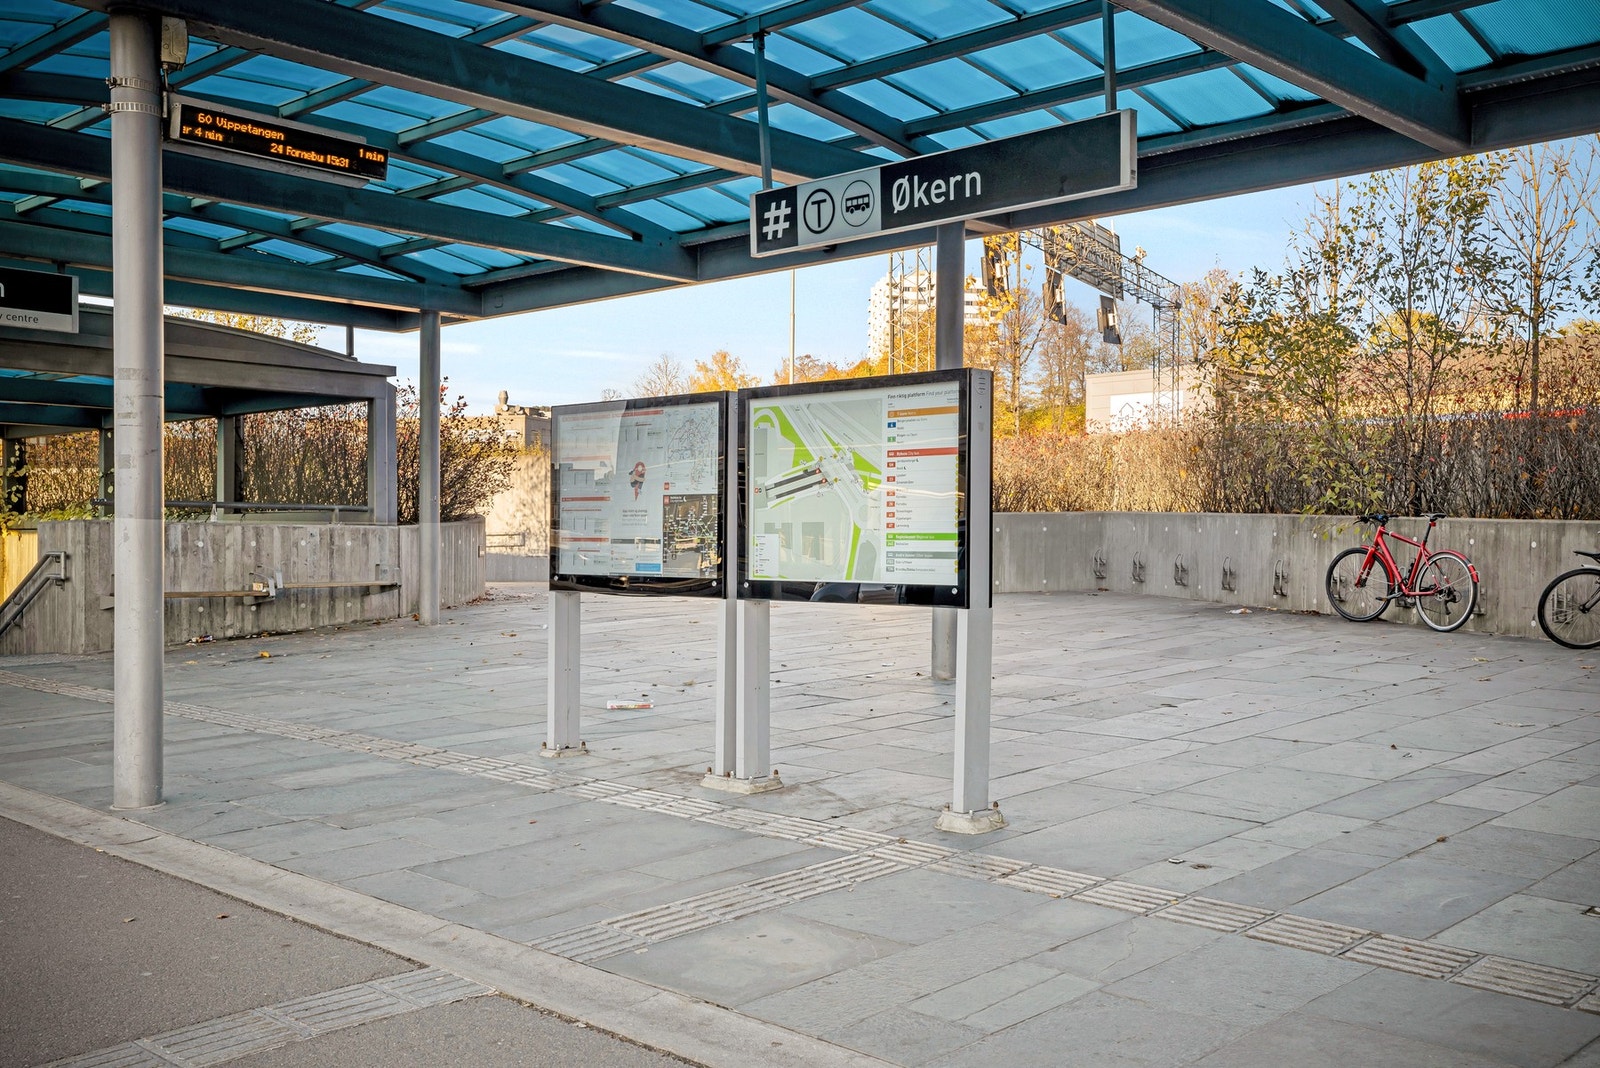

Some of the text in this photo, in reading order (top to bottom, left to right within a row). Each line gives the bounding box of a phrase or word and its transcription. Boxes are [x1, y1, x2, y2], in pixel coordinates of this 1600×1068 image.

[195, 127, 202, 137] 4
[204, 129, 223, 142] min
[270, 142, 283, 154] 24
[286, 145, 324, 163] Fornebu
[197, 112, 385, 163] 60 Vippetangen 1 min
[892, 171, 982, 214] Økern
[6, 313, 39, 324] centre
